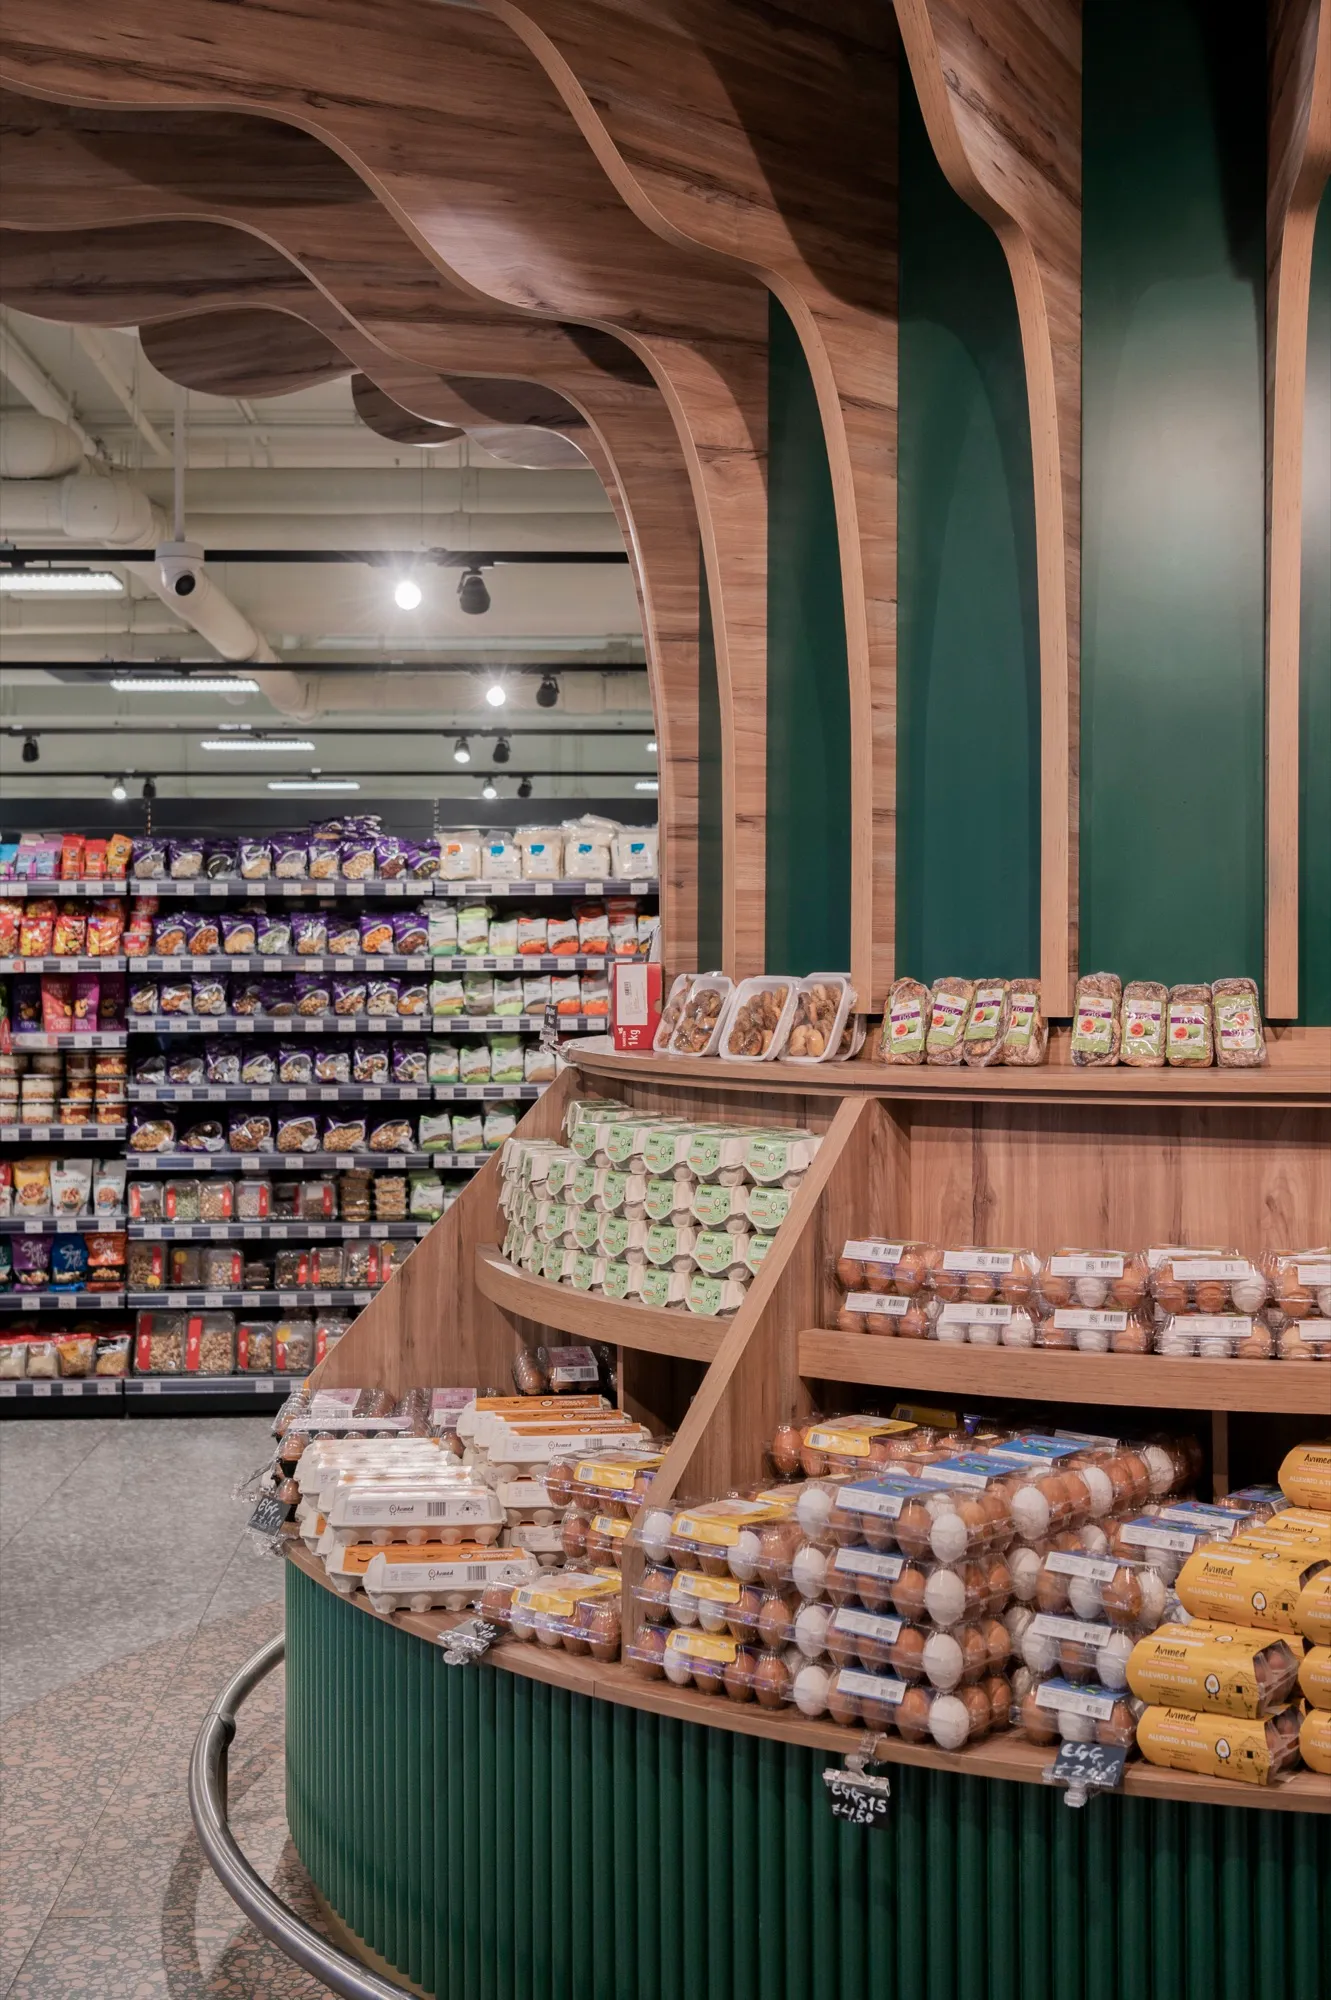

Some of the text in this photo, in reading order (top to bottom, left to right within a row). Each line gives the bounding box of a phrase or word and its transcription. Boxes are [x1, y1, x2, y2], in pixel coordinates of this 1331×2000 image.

[899, 1013, 912, 1021] FIGS
[941, 1006, 956, 1015] FIGS
[628, 1029, 641, 1046] 1kg
[1203, 1562, 1234, 1576] Avimed
[1155, 1644, 1187, 1658] Avimed
[1138, 1669, 1198, 1685] ALLEVATO A TERRA
[1165, 1708, 1198, 1722] Avimed
[1148, 1733, 1179, 1745] ALLEVATO
[1187, 1740, 1209, 1750] TERRA
[1061, 1743, 1104, 1764] EGG
